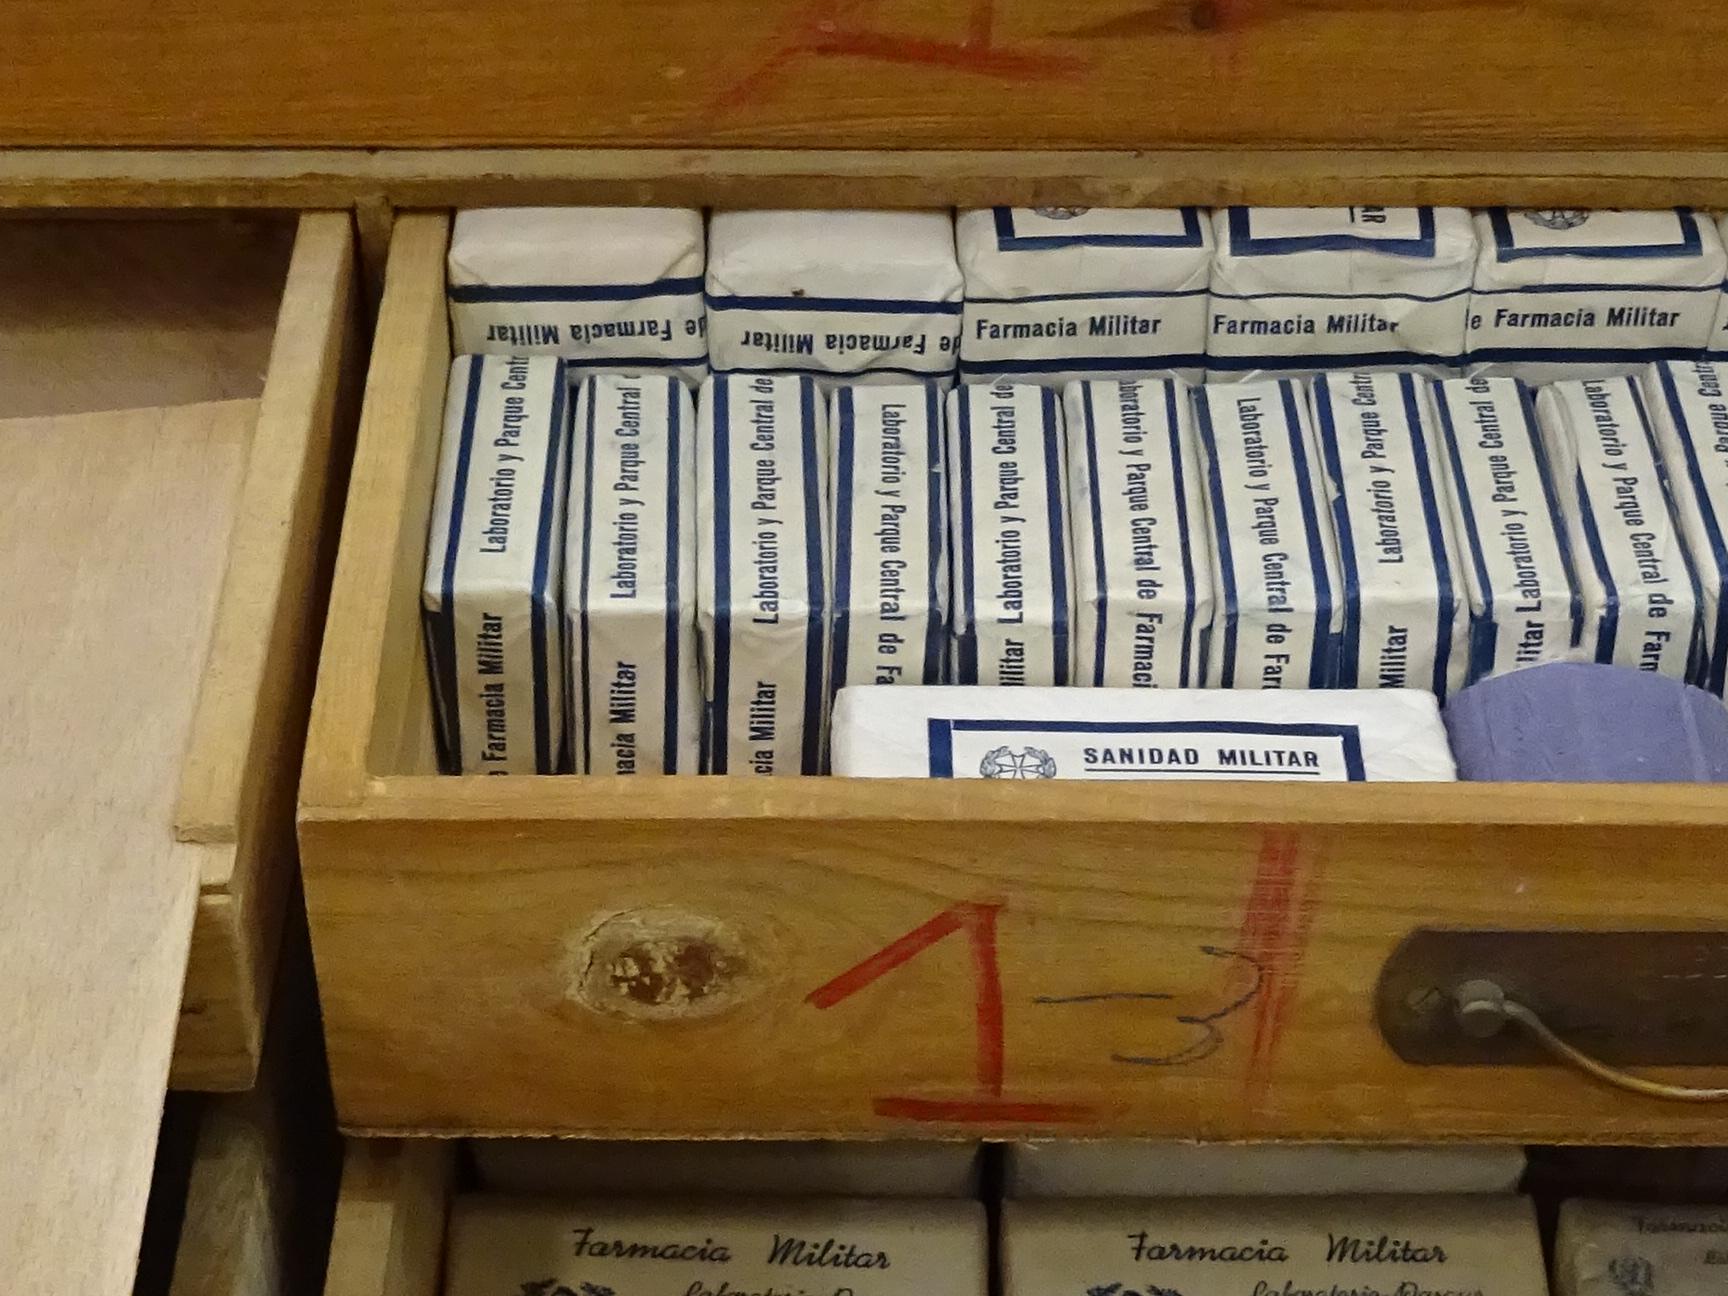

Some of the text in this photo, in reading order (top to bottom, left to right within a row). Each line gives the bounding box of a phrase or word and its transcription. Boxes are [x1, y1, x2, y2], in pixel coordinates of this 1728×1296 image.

[486, 319, 672, 344] Farmacia Militar
[741, 332, 926, 355] Farmacia Militar
[976, 316, 1162, 341] Farmacia Militar
[1213, 314, 1399, 335] Farmacia Militar
[1494, 307, 1681, 329] Farmacia Militar
[495, 395, 531, 447] Parque
[617, 386, 642, 439] Central
[749, 396, 776, 450] Central
[992, 403, 1016, 455] Central
[1478, 396, 1503, 451] Central
[500, 453, 525, 463] y
[614, 441, 647, 501] Parque
[1129, 450, 1144, 458] y
[1489, 455, 1518, 504] Parque
[480, 462, 517, 553] Laboratorio
[619, 497, 646, 507] y
[751, 455, 784, 510] Parque
[995, 461, 1026, 511] Parque
[1122, 463, 1152, 512] Parque
[1361, 407, 1404, 564] Laboratorio y Parque
[1582, 379, 1668, 619] Laboratorio y Parque Central de
[757, 518, 783, 528] y
[875, 404, 907, 655] Laboratorio y Parque Central de
[1000, 515, 1026, 526] y
[1237, 397, 1294, 644] Laboratorio y Parque Central de
[1500, 508, 1528, 518] y
[610, 512, 639, 599] Laboratorio
[1130, 516, 1158, 571] Central
[1500, 519, 1542, 613] Laboratorio
[752, 534, 780, 625] Laboratorio
[995, 531, 1024, 624] Laboratorio
[1135, 576, 1158, 600] de
[477, 612, 504, 675] Militar
[1379, 625, 1408, 689] Militar
[609, 661, 638, 725] Militar
[749, 680, 777, 742] Militar
[481, 683, 507, 762] Farmacia
[1084, 748, 1320, 767] SANIDAD MILITAR
[572, 1227, 891, 1270] Farmacia Militar
[1127, 1230, 1448, 1265] Farmacia Militar
